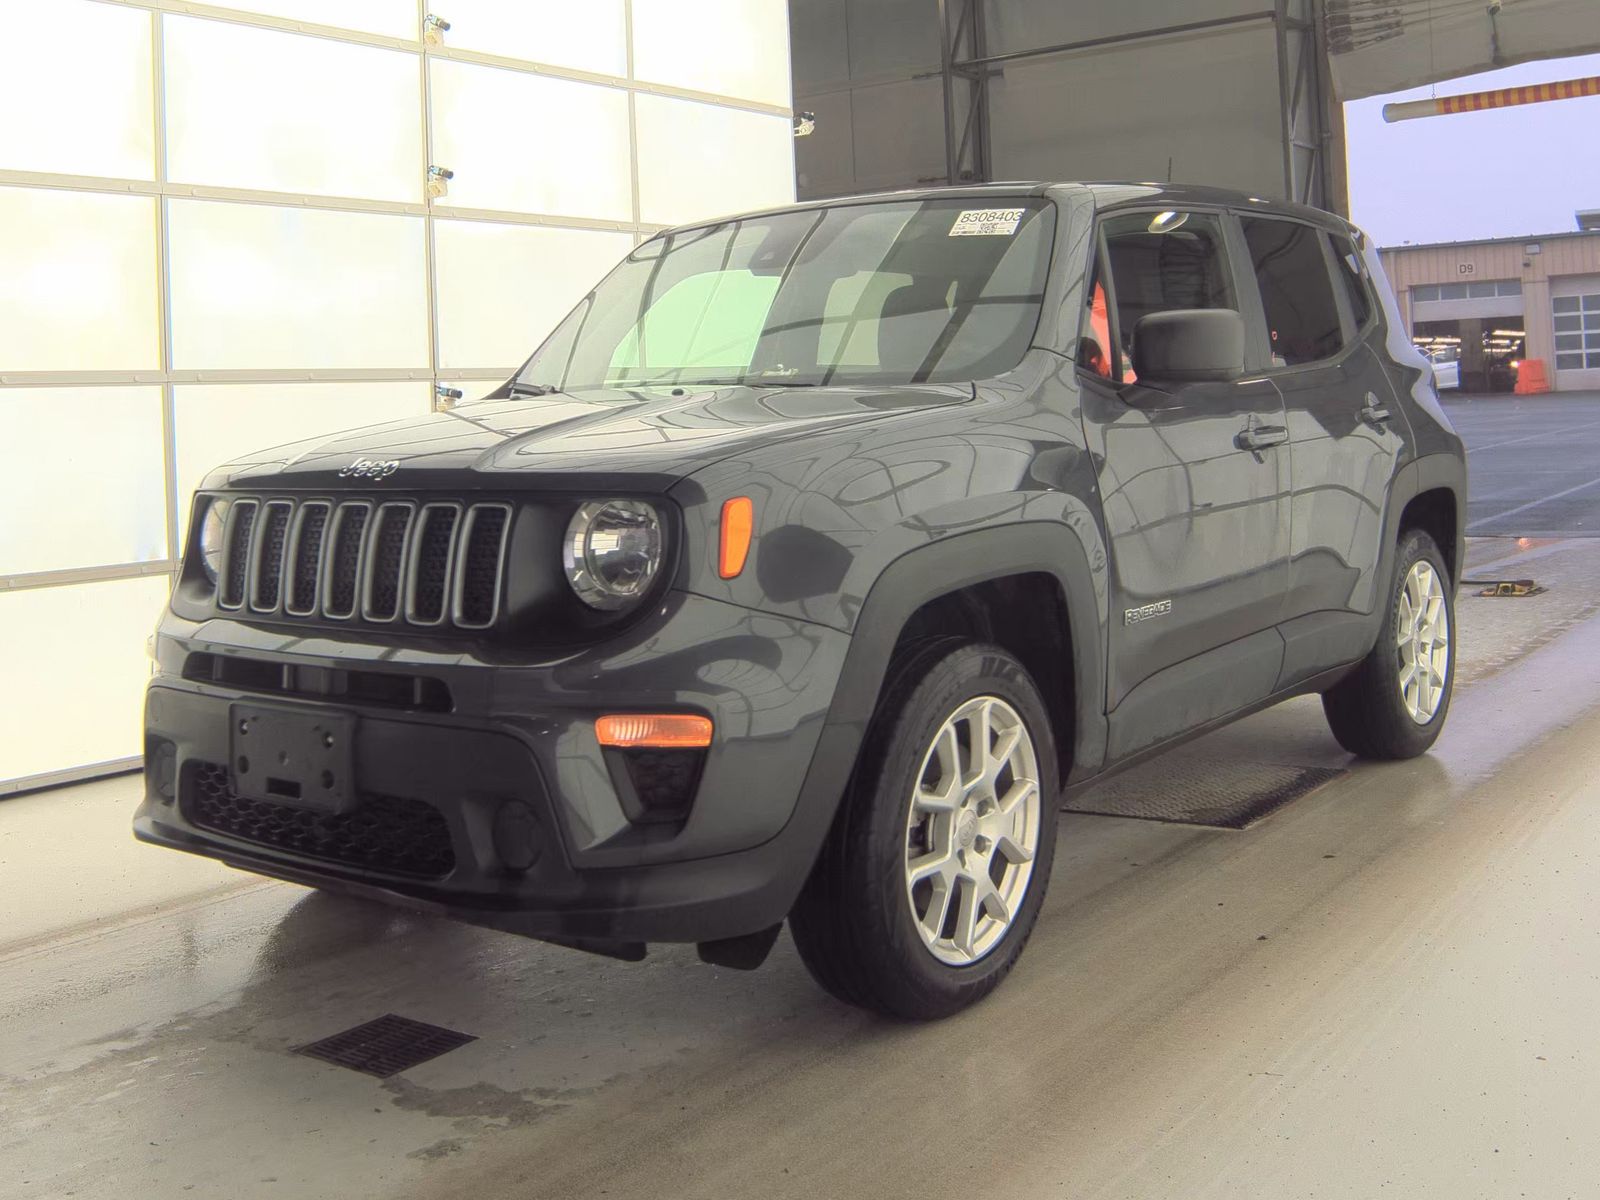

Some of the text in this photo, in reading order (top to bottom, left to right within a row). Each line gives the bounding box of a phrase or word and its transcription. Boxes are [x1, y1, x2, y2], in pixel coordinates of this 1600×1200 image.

[960, 211, 1023, 223] 8308403
[1459, 264, 1473, 274] D9
[338, 457, 400, 480] Jeep
[1124, 600, 1172, 626] RENEGADE
